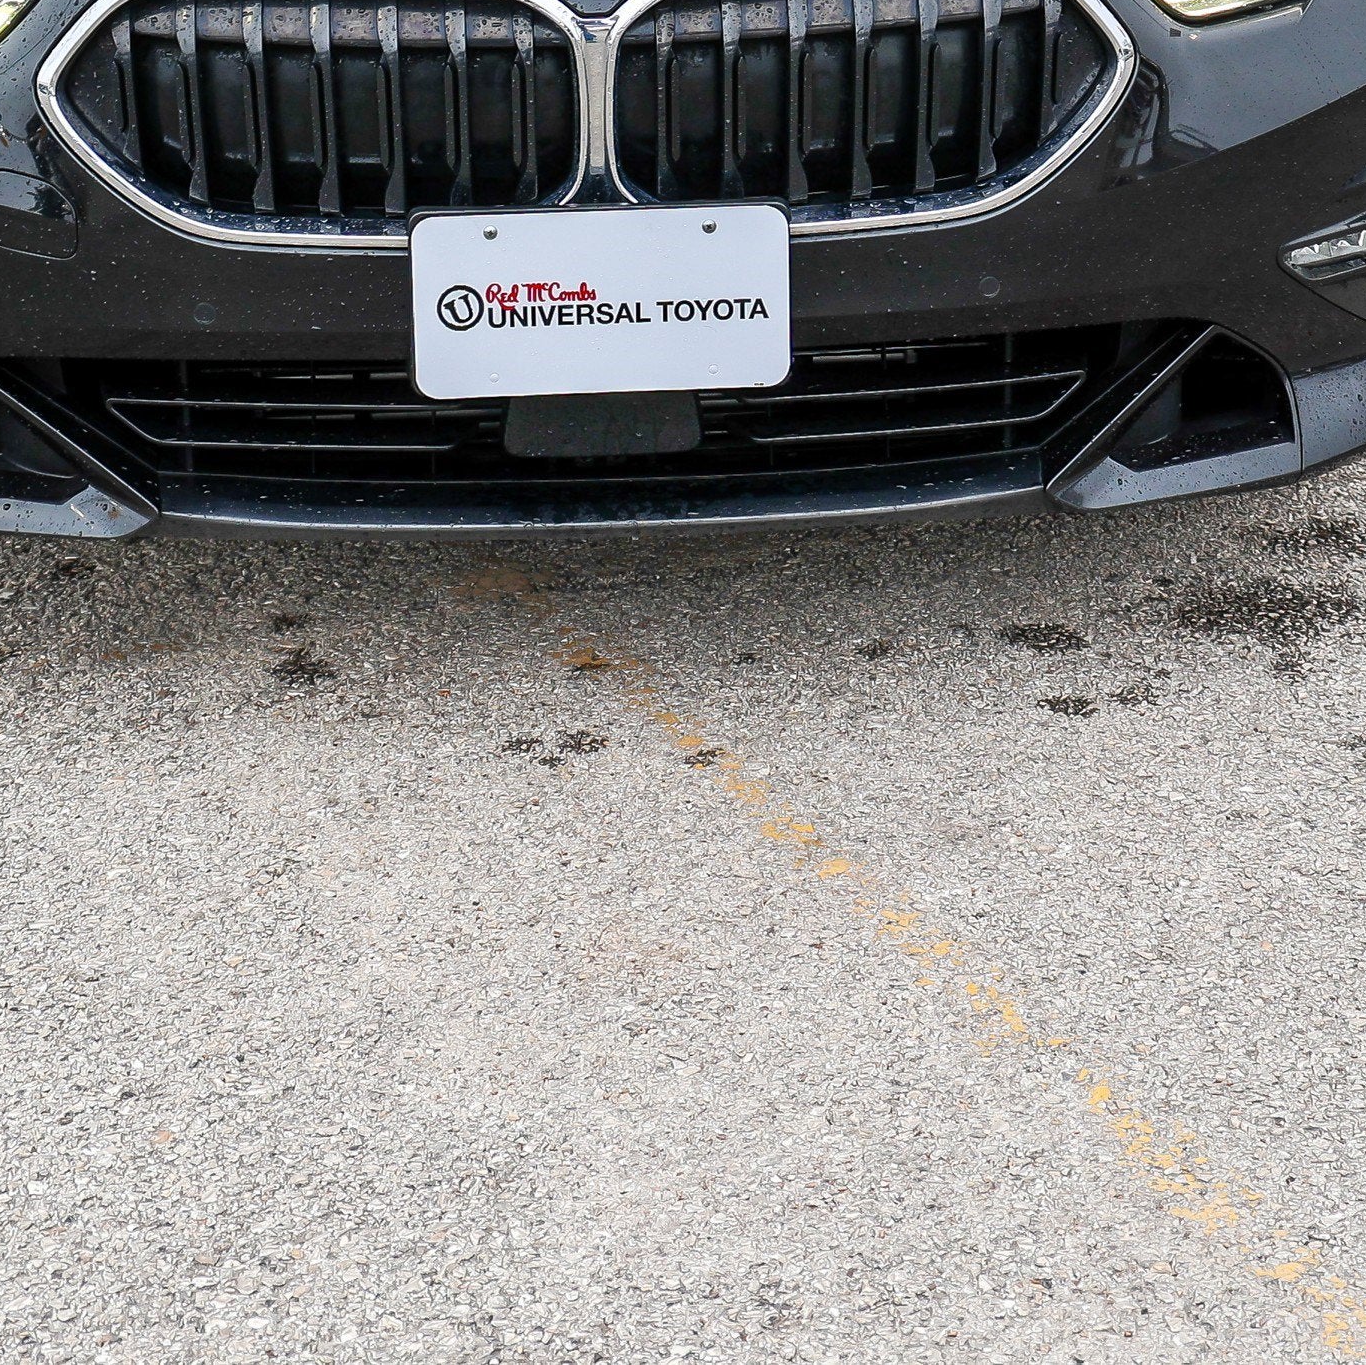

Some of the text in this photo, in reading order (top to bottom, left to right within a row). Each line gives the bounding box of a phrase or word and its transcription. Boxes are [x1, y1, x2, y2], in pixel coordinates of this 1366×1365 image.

[486, 282, 597, 311] Red McCombs
[488, 298, 770, 329] UNIVERSAL TOYOTA
